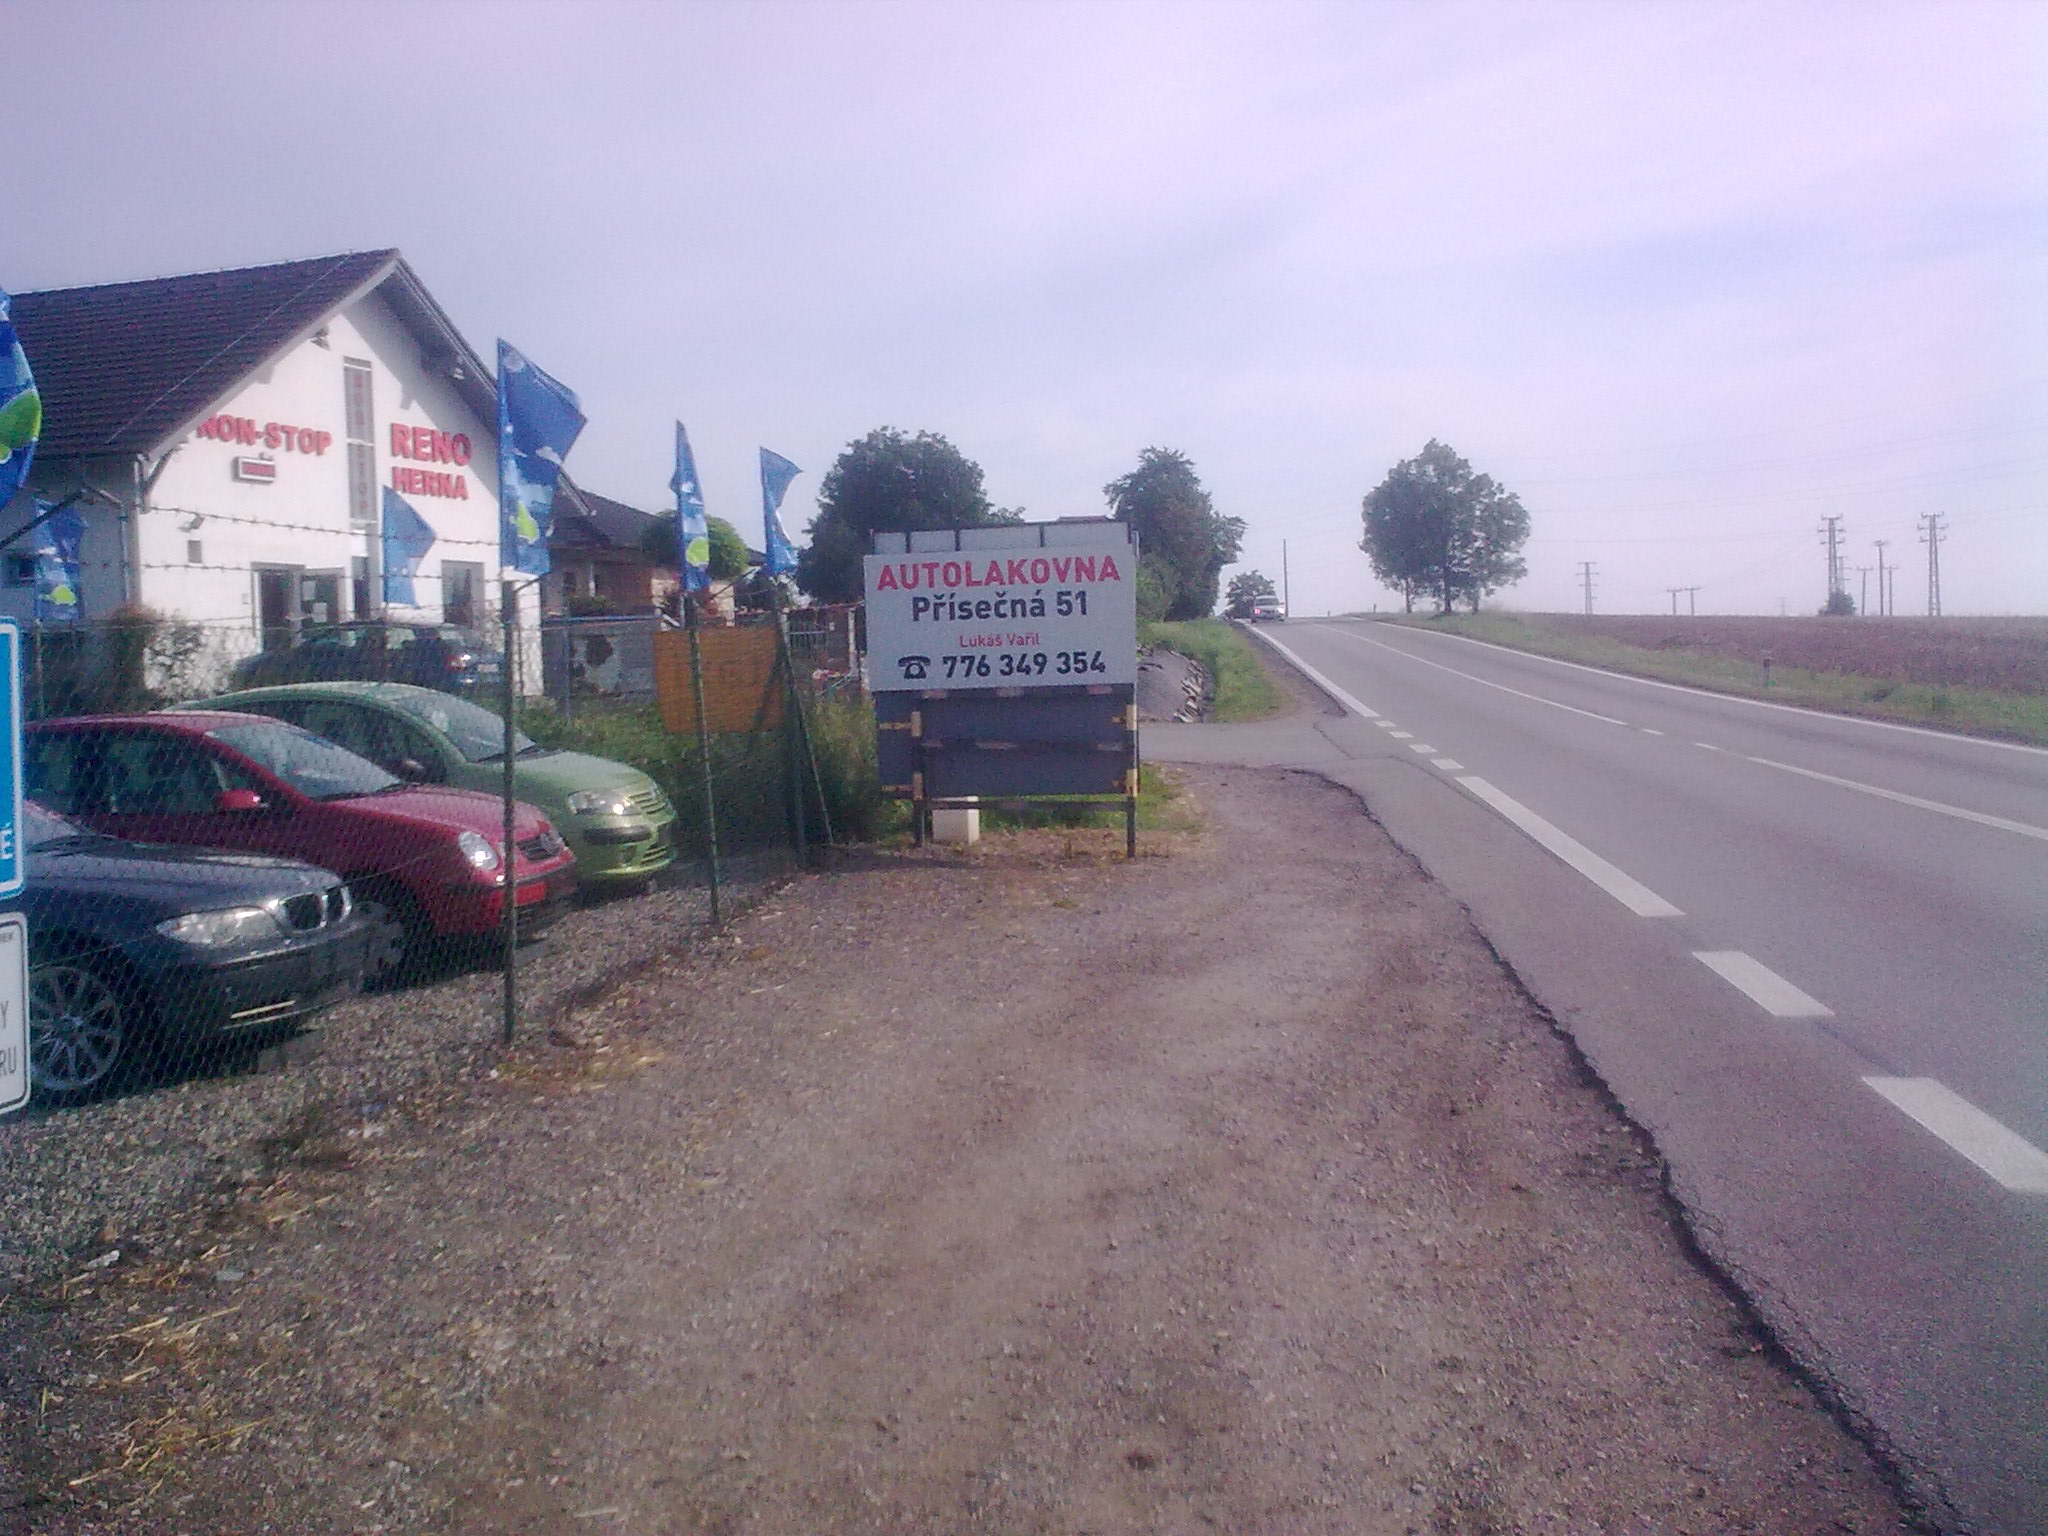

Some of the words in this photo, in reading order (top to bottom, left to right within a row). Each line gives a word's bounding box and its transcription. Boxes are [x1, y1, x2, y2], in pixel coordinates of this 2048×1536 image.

[197, 411, 333, 456] NON-STOP
[390, 422, 473, 467] RENO
[391, 466, 469, 500] HERNA
[876, 555, 1120, 591] AUTOLAKOVNA
[911, 589, 1046, 622] Přísečná
[1056, 590, 1088, 617] 51
[959, 632, 1003, 648] Lukáš
[942, 654, 991, 679] 776
[1000, 652, 1048, 676] 349
[1056, 650, 1106, 675] 354
